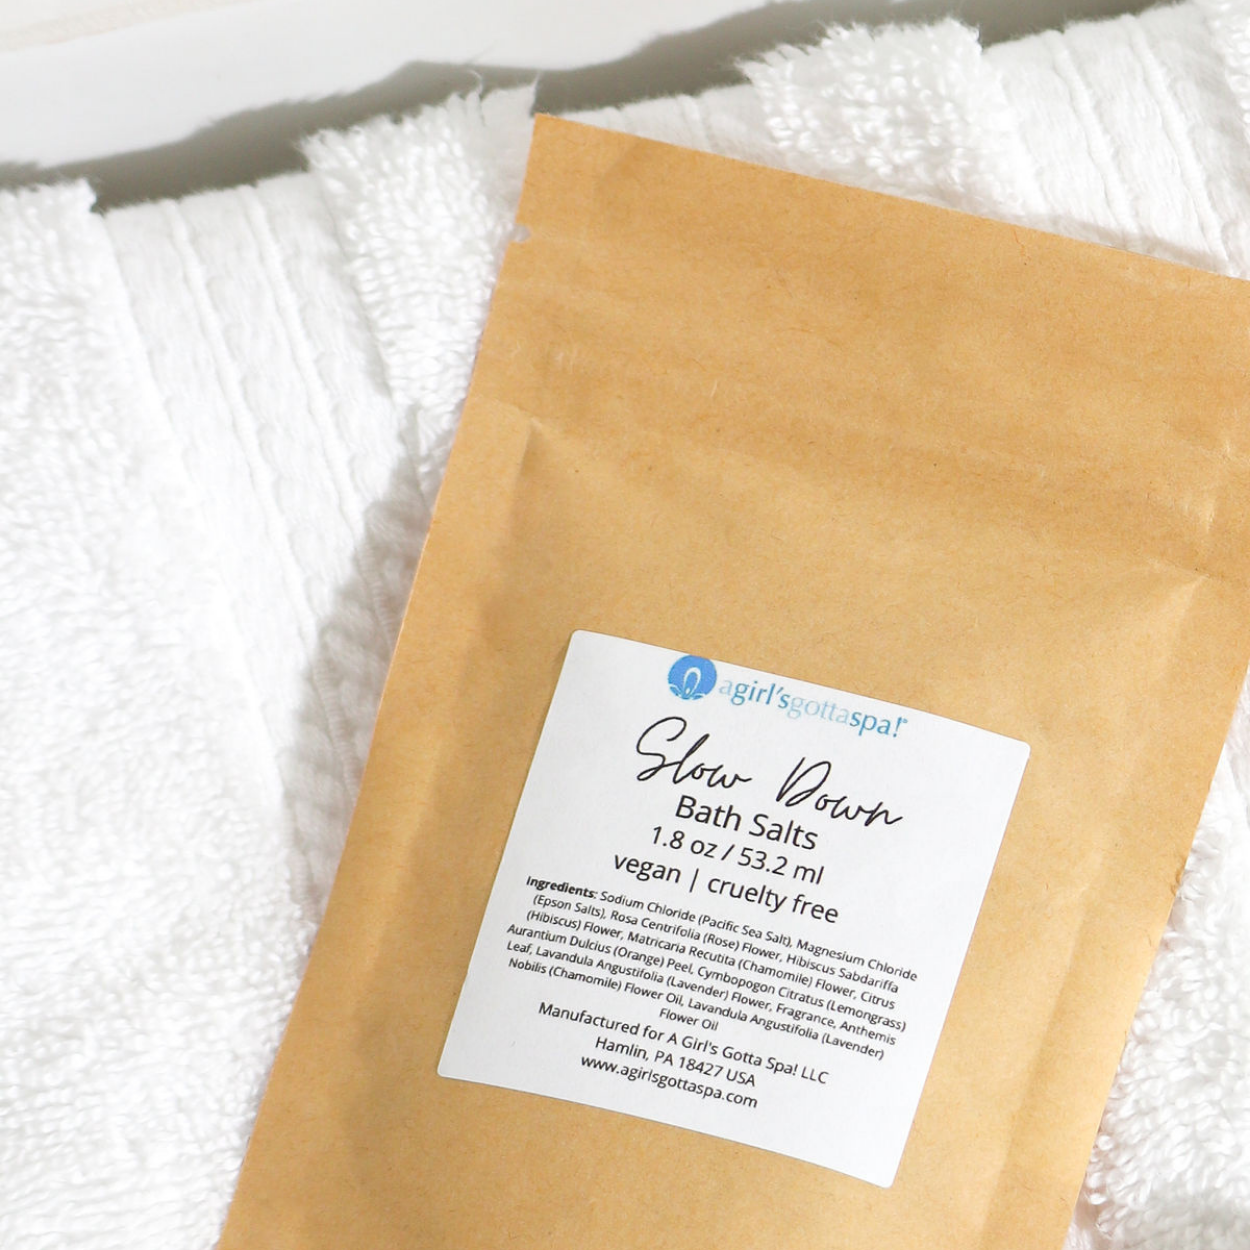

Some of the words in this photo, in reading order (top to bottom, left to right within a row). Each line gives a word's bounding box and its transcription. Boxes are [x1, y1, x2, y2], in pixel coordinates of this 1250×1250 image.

[635, 715, 753, 790] Slow
[775, 756, 904, 828] Down
[653, 825, 686, 850] 1.8
[689, 839, 719, 859] oz
[737, 846, 789, 877] 53.2
[792, 864, 825, 886] ml
[674, 794, 742, 832] Bath
[748, 813, 819, 851] Salts
[525, 875, 599, 900] Ingredients:
[599, 890, 645, 910] Sodium
[646, 901, 696, 923] Chloride
[697, 914, 740, 934] (Pacific
[740, 924, 763, 939] Sea
[764, 930, 793, 949] Salt),
[796, 938, 865, 967] Magnesium
[867, 958, 918, 982] Chloride
[614, 854, 682, 884] vegan
[707, 877, 789, 914] cruelty
[791, 893, 839, 924] free
[506, 923, 568, 945] Aurantium
[568, 935, 612, 955] Dulcius
[612, 945, 665, 968] (Orange)
[665, 957, 694, 975] Peel,
[697, 965, 776, 995] Cymbopogon
[777, 986, 825, 1008] Citratus
[826, 999, 907, 1033] (Lemongrass)
[526, 909, 582, 932] (Hibiscus)
[582, 921, 624, 941] Flower,
[626, 930, 687, 954] Matricaria
[688, 945, 736, 967] Recutita
[737, 958, 814, 989] (Chamomile)
[814, 978, 857, 1000] Flower,
[860, 991, 896, 1010] Citrus
[532, 893, 572, 911] (Epson
[573, 901, 607, 920] Salts),
[609, 909, 639, 926] Rosa
[640, 917, 701, 941] Centrifolia
[702, 932, 740, 952] (Rose)
[741, 941, 783, 963] Flower,
[785, 953, 836, 976] Hibiscus
[837, 967, 899, 994] Sabdariffa
[506, 940, 534, 956] Leaf,
[535, 945, 594, 967] Lavandula
[595, 958, 665, 984] Angustifolia
[666, 975, 729, 1002] (Lavender)
[730, 991, 773, 1013] Flower,
[775, 1002, 837, 1030] Fragrance,
[839, 1020, 897, 1046] Anthemis
[508, 957, 548, 974] Nobilis
[548, 965, 623, 992] (Chamomile)
[623, 981, 665, 1000] Flower
[665, 992, 685, 1008] Oil,
[687, 997, 748, 1022] Lavandula
[749, 1014, 819, 1041] Angustifolia
[821, 1032, 885, 1061] (Lavender)
[658, 1007, 700, 1026] Flower
[701, 1018, 719, 1032] Oil
[538, 1001, 641, 1036] Manufactured
[642, 1024, 666, 1042] for
[666, 1032, 678, 1046] A
[681, 1035, 719, 1056] Girl's
[721, 1045, 763, 1067] Gotta
[765, 1056, 799, 1077] Spa!
[800, 1066, 830, 1085] LLC
[581, 1056, 758, 1109] www.agirlsgottaspa.com
[594, 1035, 649, 1062] Hamlin,
[653, 1049, 674, 1067] PA
[679, 1056, 724, 1078] 18427
[725, 1068, 756, 1088] USA
